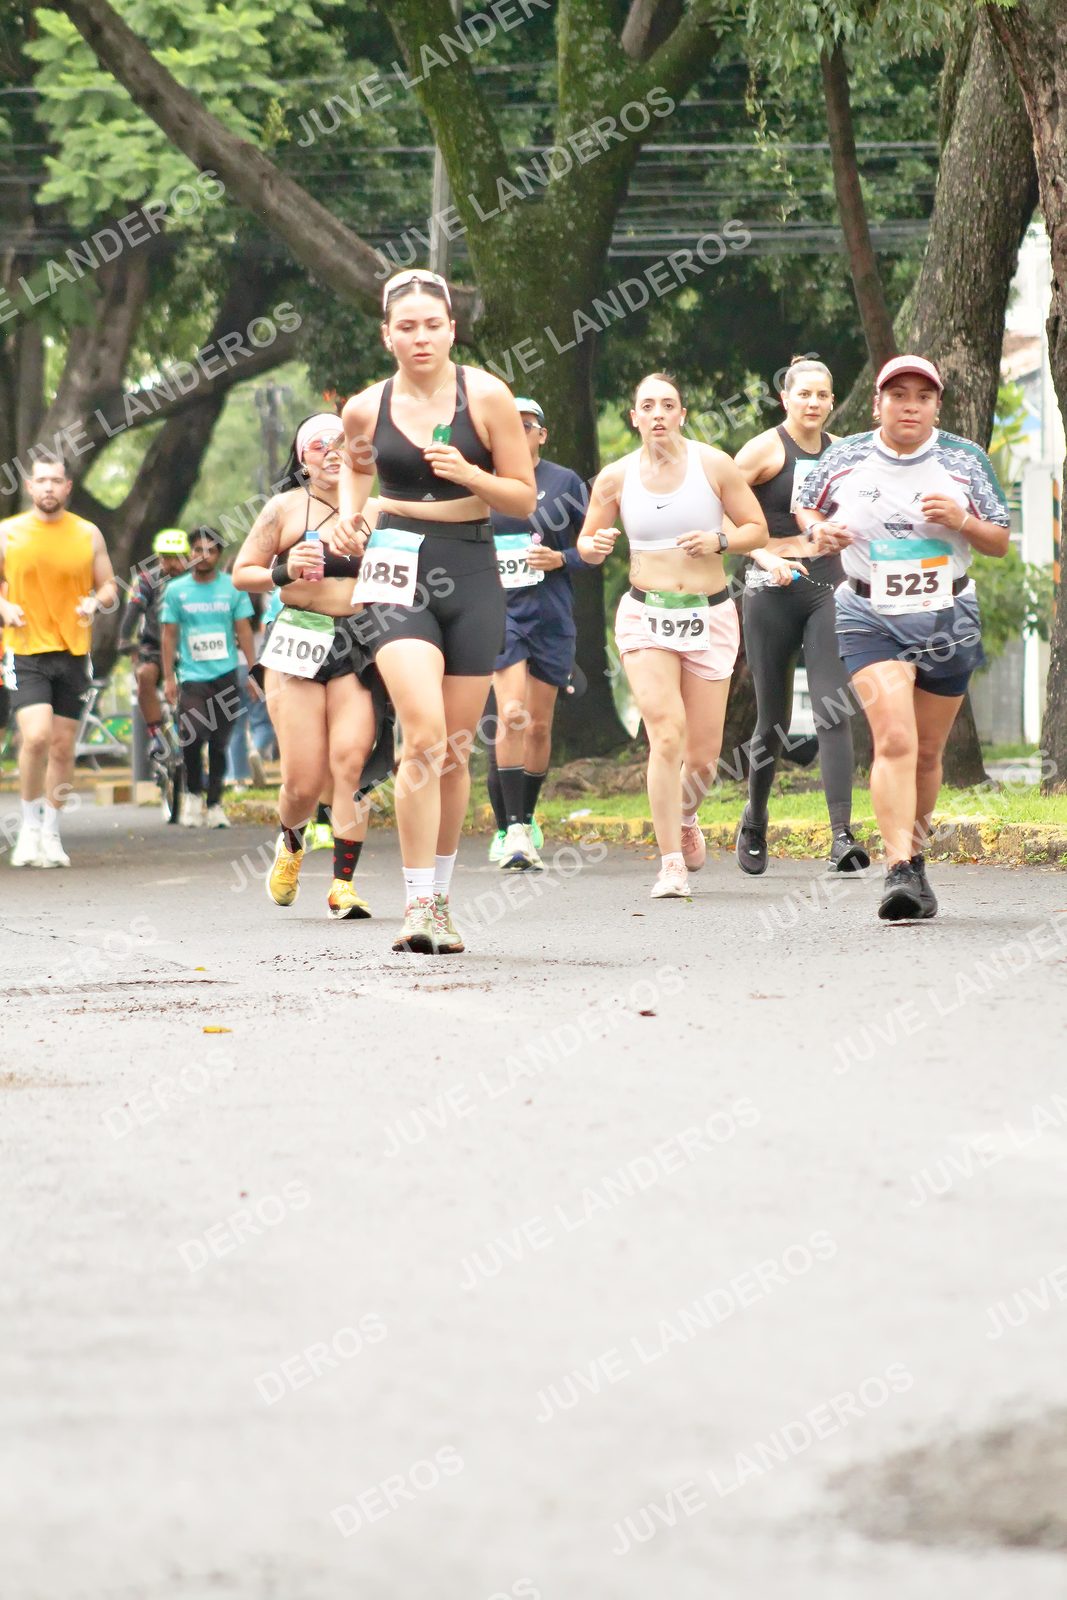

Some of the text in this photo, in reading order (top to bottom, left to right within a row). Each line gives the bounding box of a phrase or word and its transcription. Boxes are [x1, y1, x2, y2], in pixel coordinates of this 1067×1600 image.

[886, 571, 939, 597] 523
[648, 617, 704, 638] 1979
[193, 639, 224, 652] 4309
[271, 635, 326, 664] 2100
